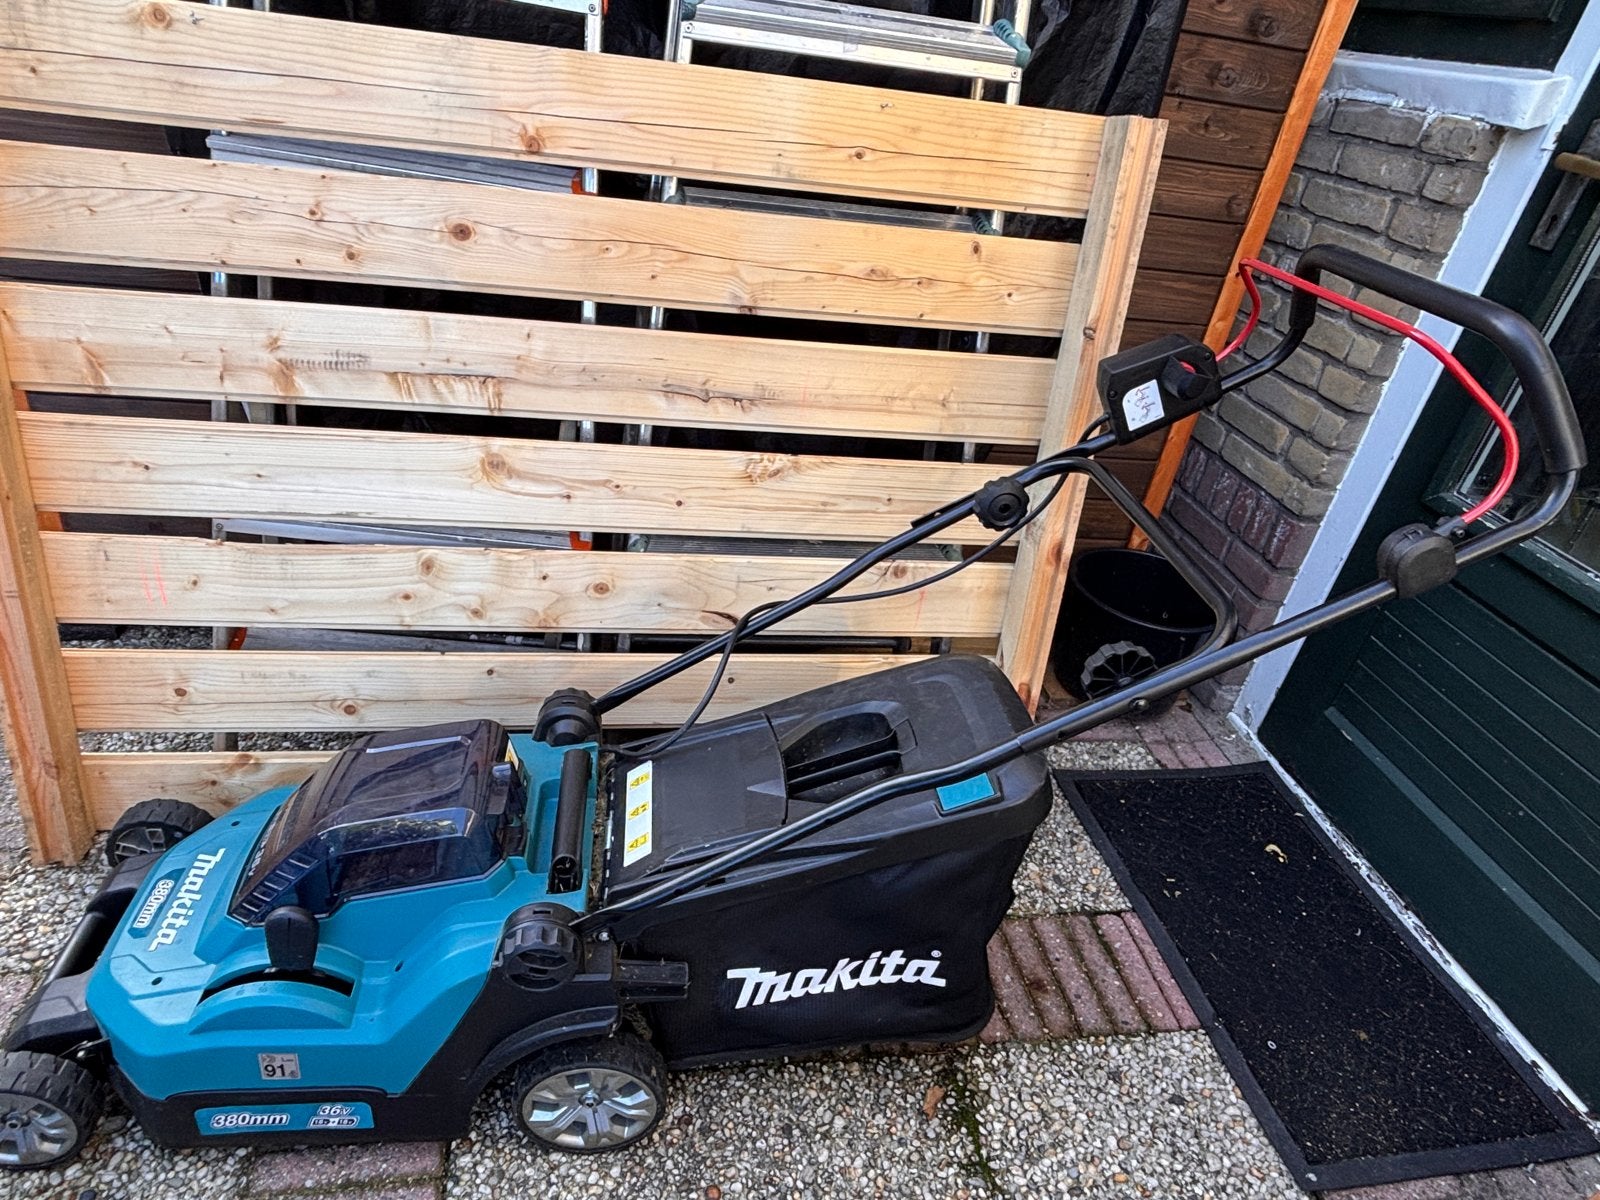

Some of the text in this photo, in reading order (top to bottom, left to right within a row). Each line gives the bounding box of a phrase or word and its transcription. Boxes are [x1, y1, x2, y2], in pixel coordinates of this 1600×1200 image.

[132, 879, 175, 928] 380mm
[264, 1063, 286, 1078] 91
[212, 1113, 289, 1128] 380mm
